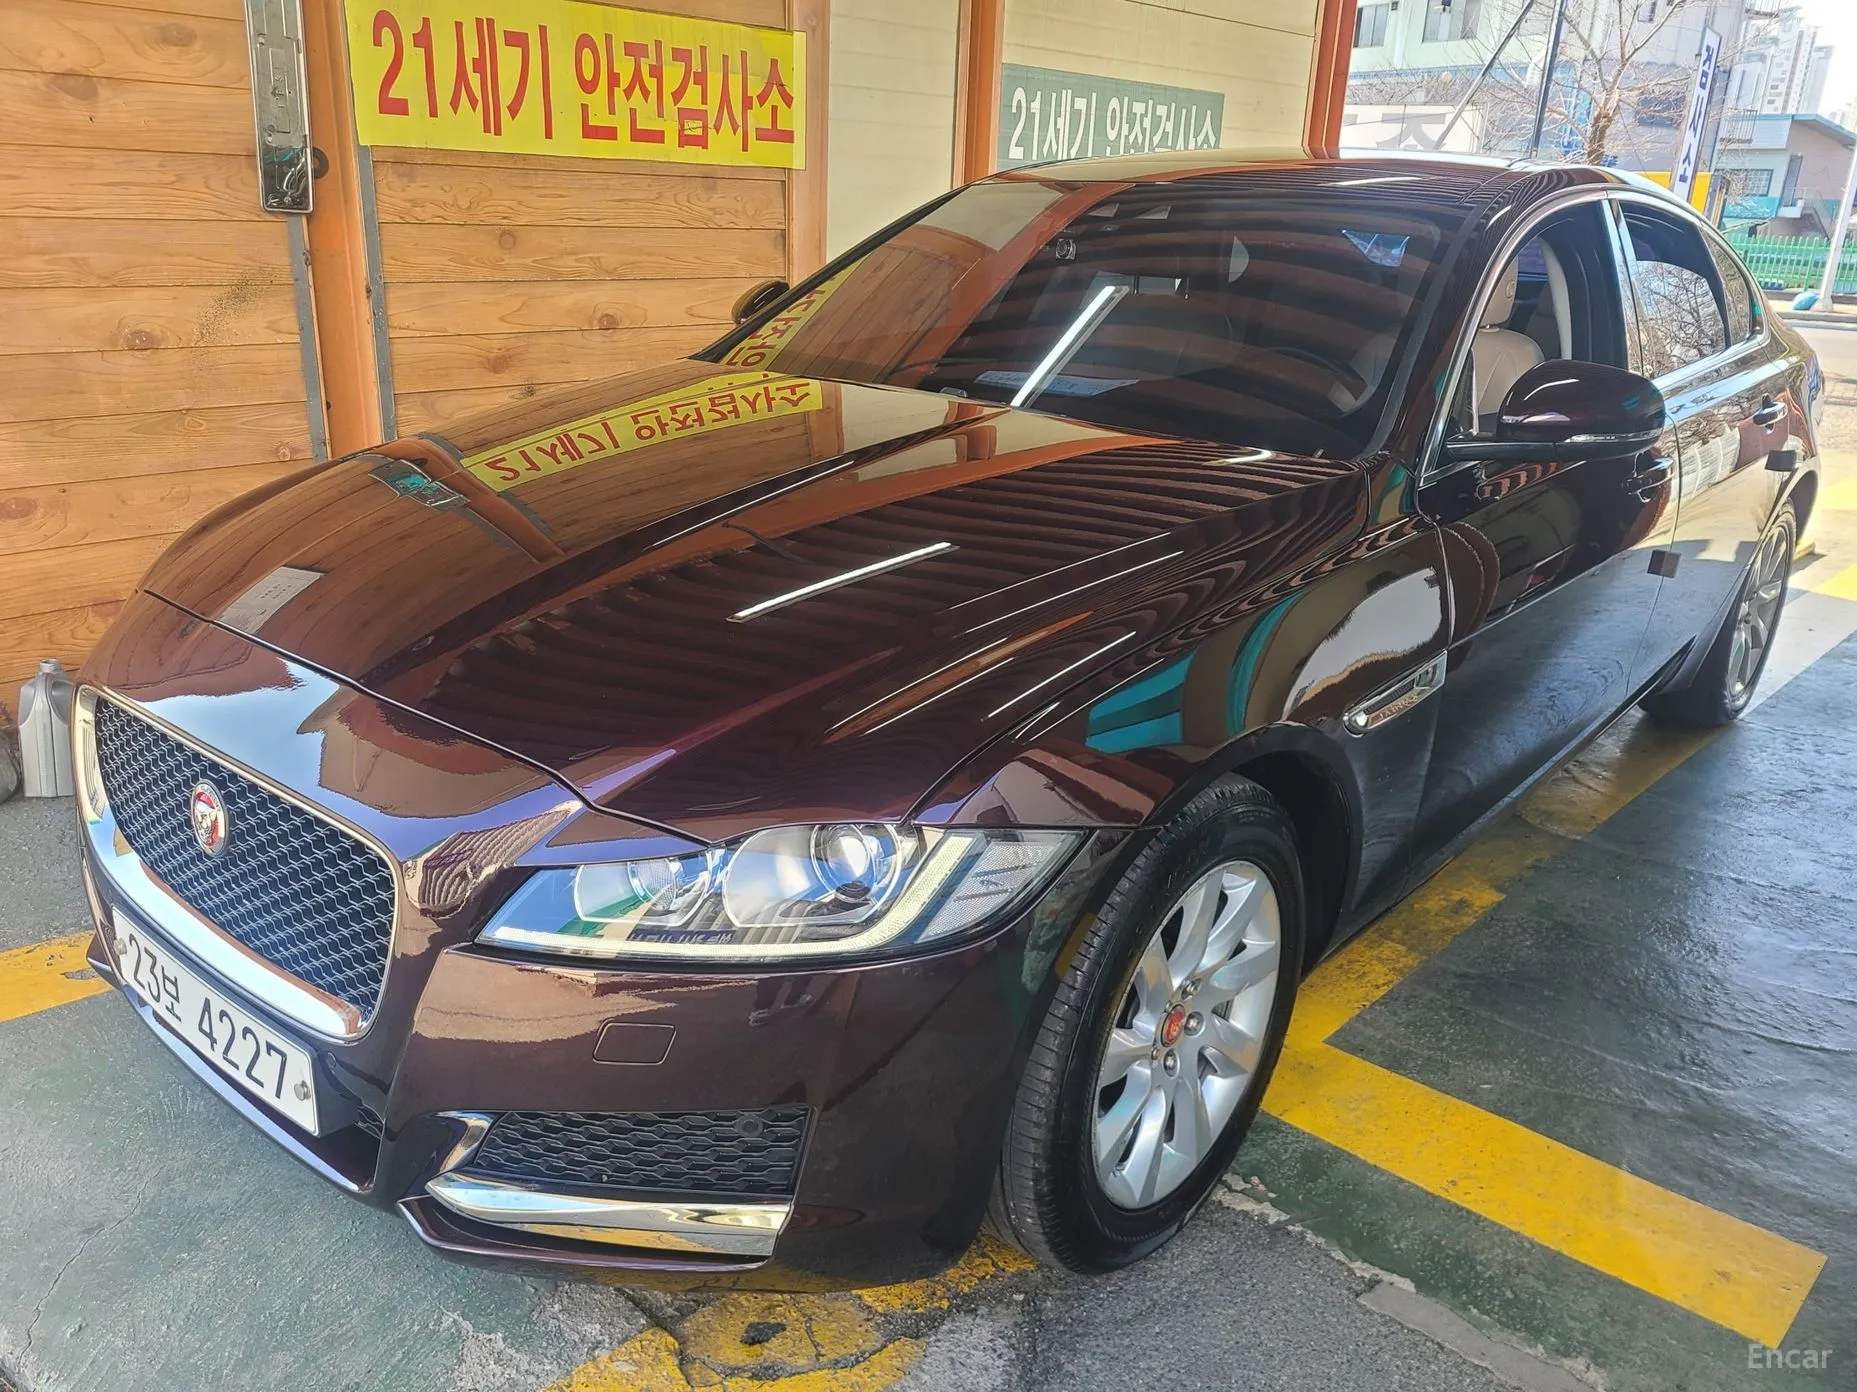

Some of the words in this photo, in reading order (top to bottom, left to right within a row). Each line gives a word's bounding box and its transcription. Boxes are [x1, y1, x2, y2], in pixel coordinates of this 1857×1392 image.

[372, 9, 554, 140] 21세기
[574, 32, 795, 152] 안전검사소
[1008, 86, 1097, 160] 21세기
[129, 933, 182, 1023] 23보
[198, 997, 287, 1099] 4227
